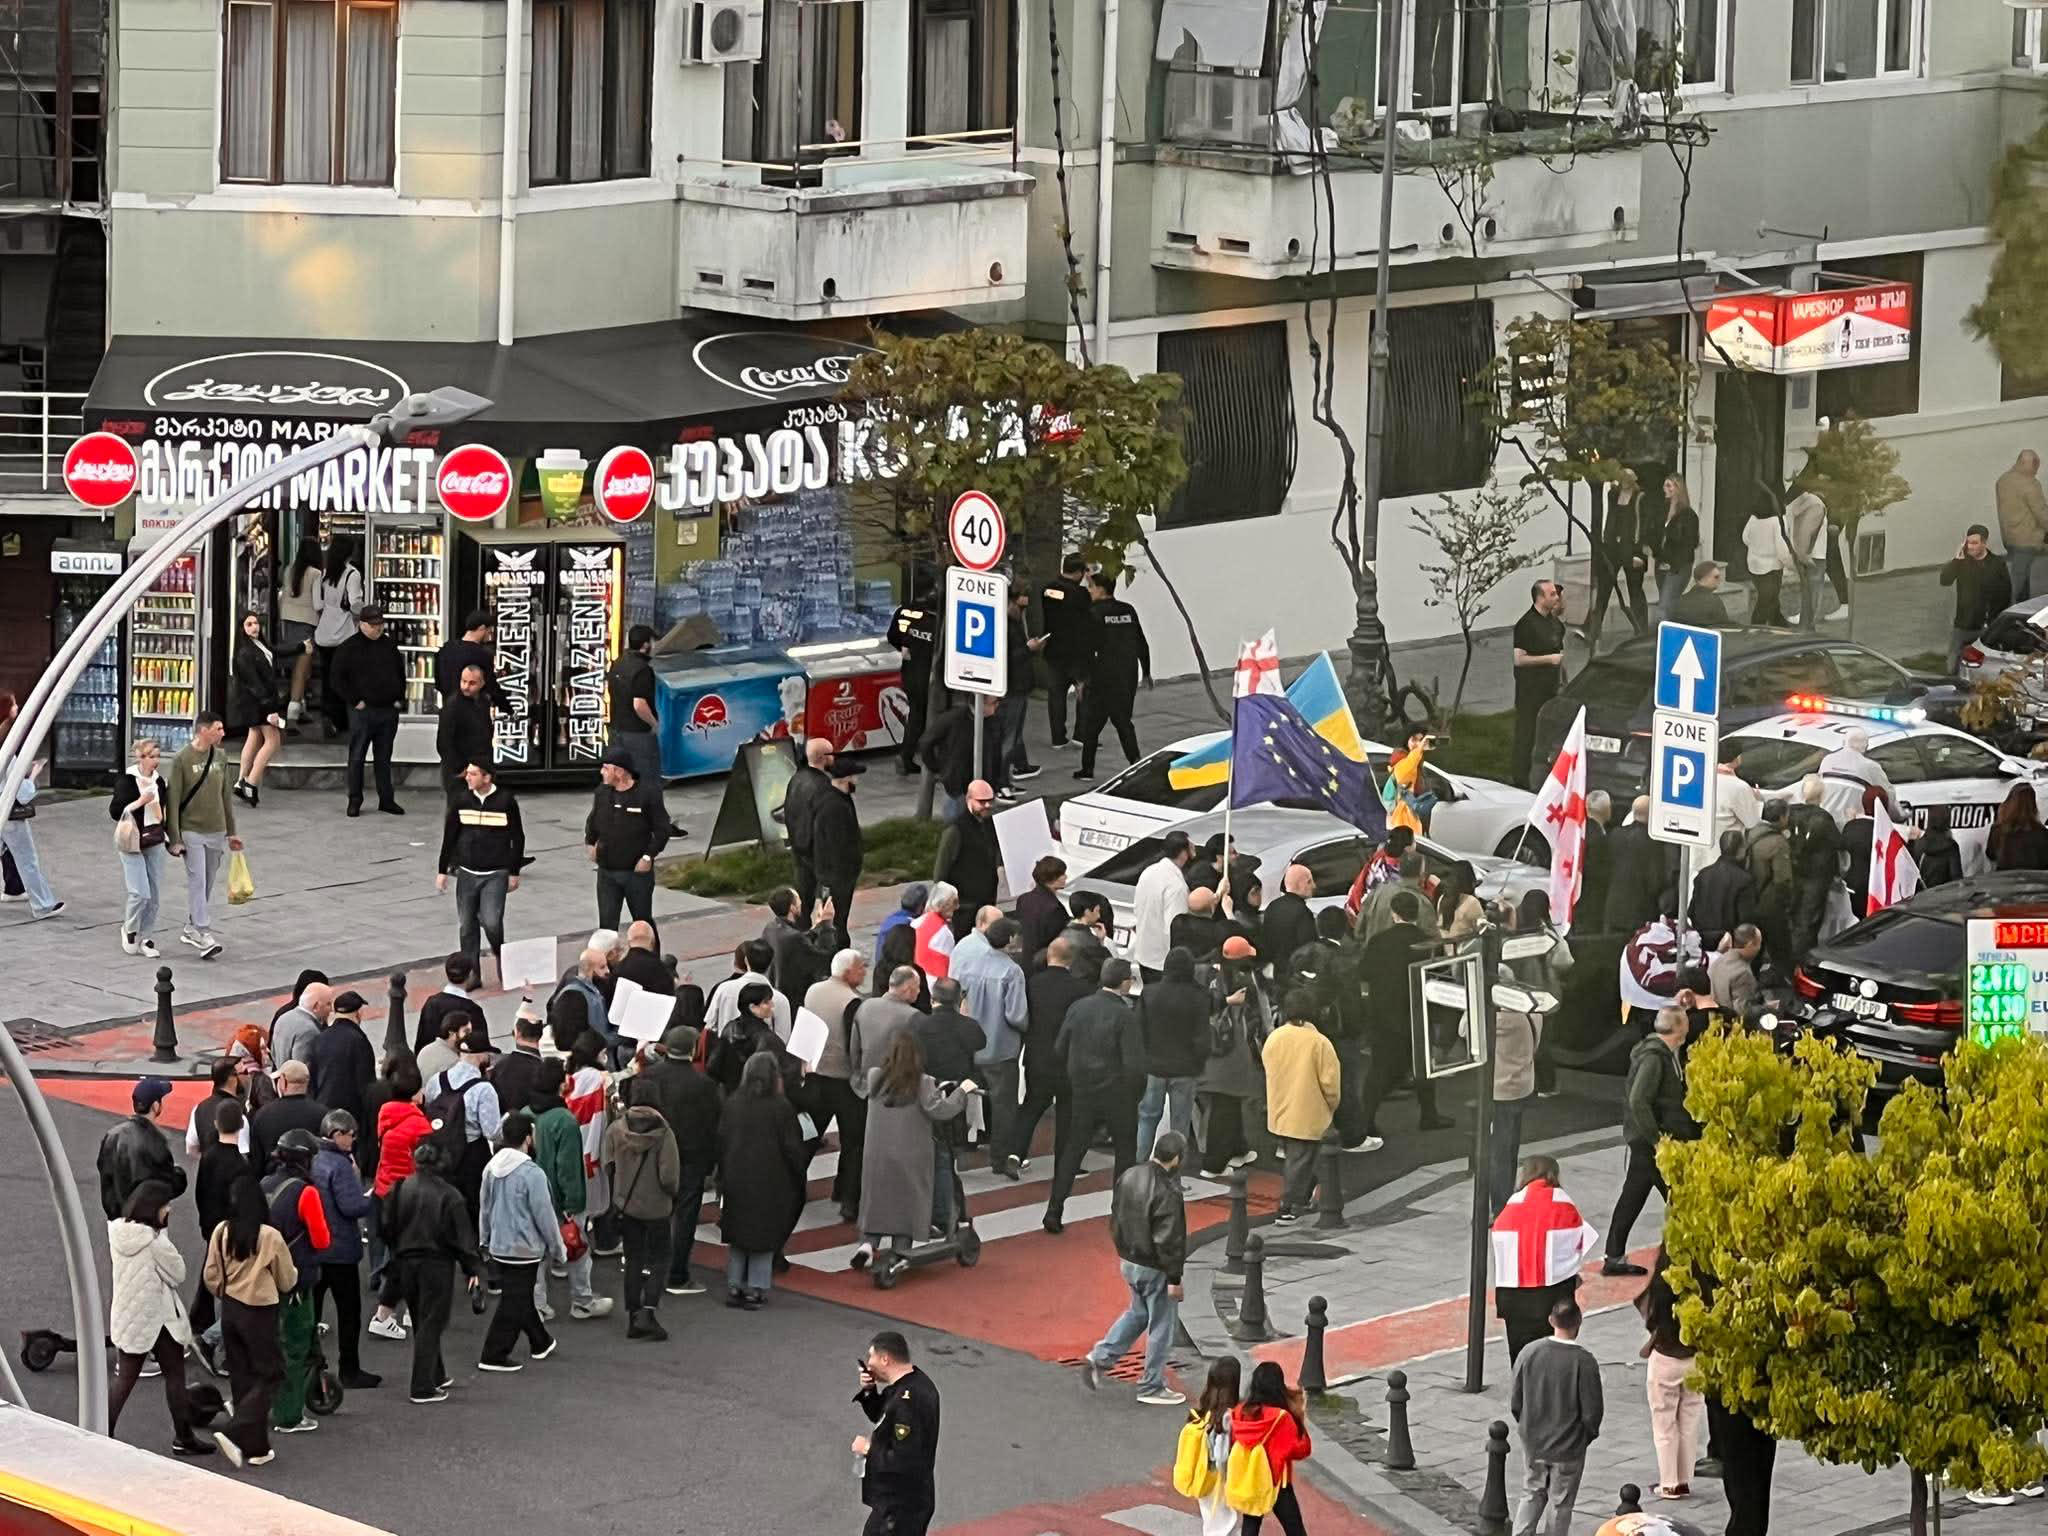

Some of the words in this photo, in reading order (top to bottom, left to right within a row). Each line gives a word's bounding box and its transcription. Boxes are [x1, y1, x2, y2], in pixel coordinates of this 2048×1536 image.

[1792, 298, 1844, 319] VAPESHOP
[154, 416, 263, 440] მარკეტი
[289, 444, 434, 514] MARKET
[961, 515, 992, 547] 40
[957, 577, 996, 597] ZONE
[964, 608, 986, 649] P
[569, 585, 606, 761] ZEDAZENI
[1664, 721, 1707, 743] ZONE
[1671, 754, 1695, 798] P
